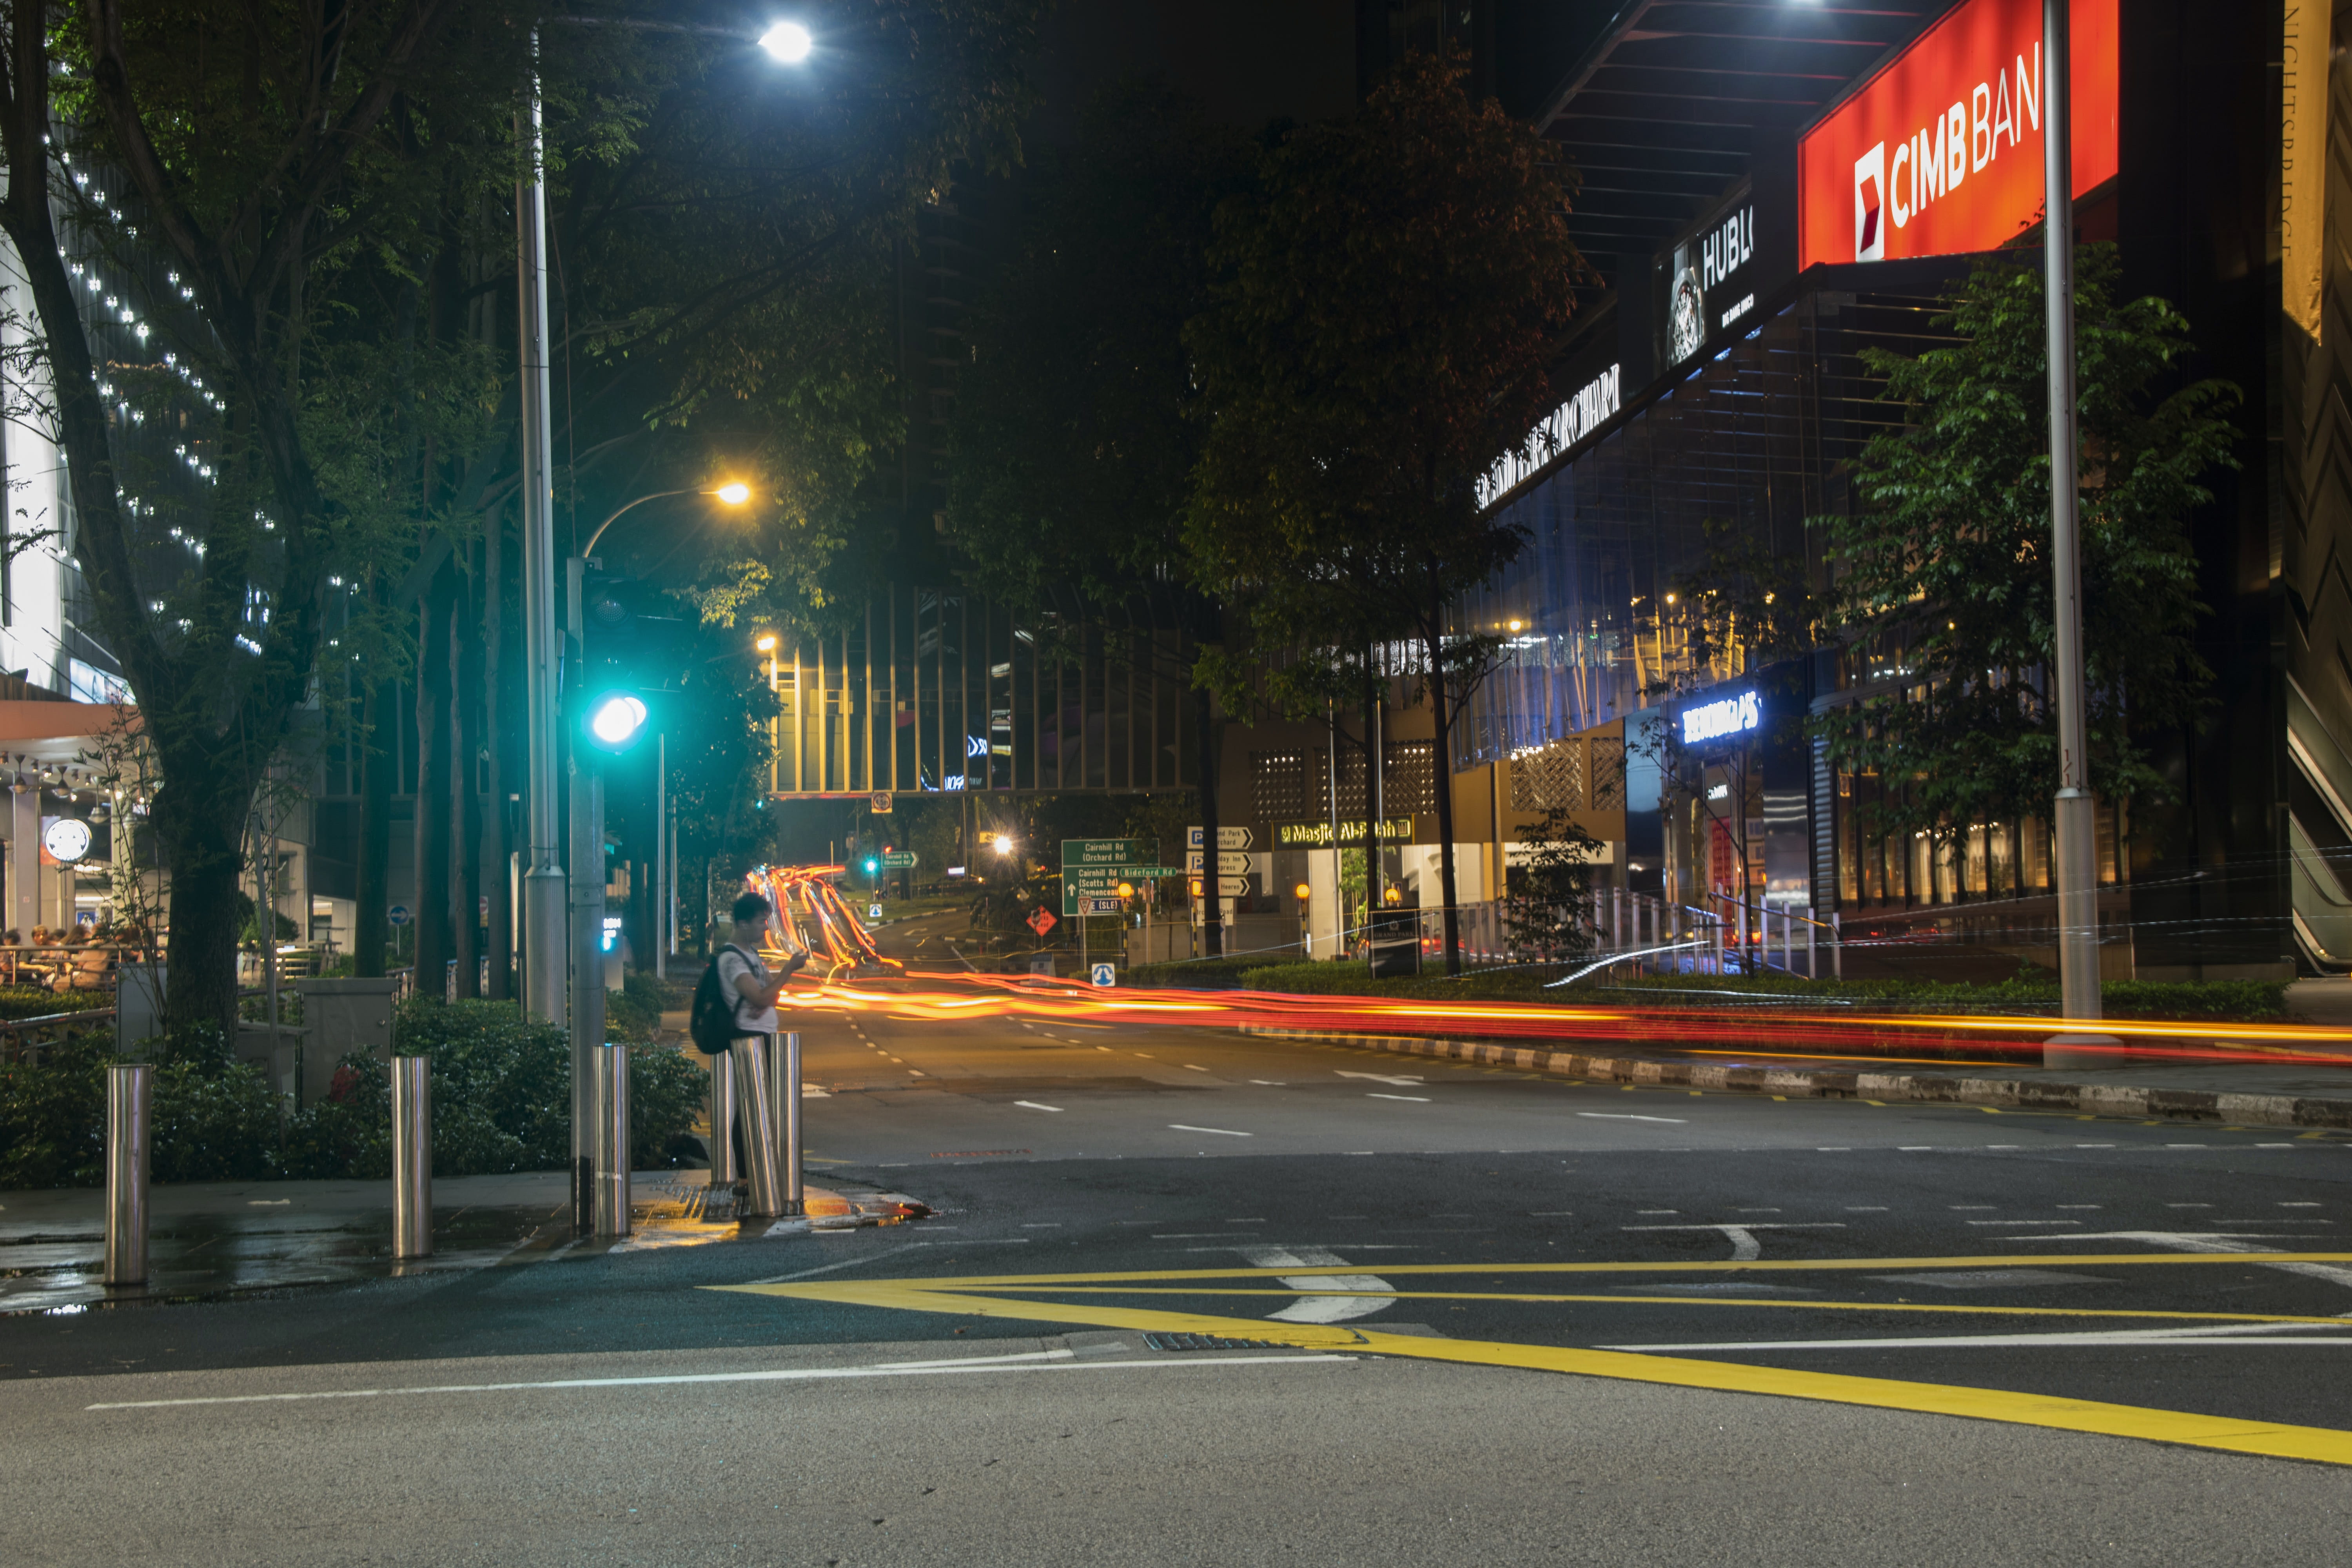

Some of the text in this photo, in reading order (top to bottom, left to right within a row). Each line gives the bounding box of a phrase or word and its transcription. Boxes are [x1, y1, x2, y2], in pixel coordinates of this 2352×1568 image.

[1890, 41, 2039, 228] CIMB BAN
[1083, 852, 1126, 862] (Orchard Rd)
[1079, 869, 1105, 877] Cairnhill
[1079, 878, 1118, 887] (Scotts Rd)
[1099, 901, 1118, 909] (SLE)
